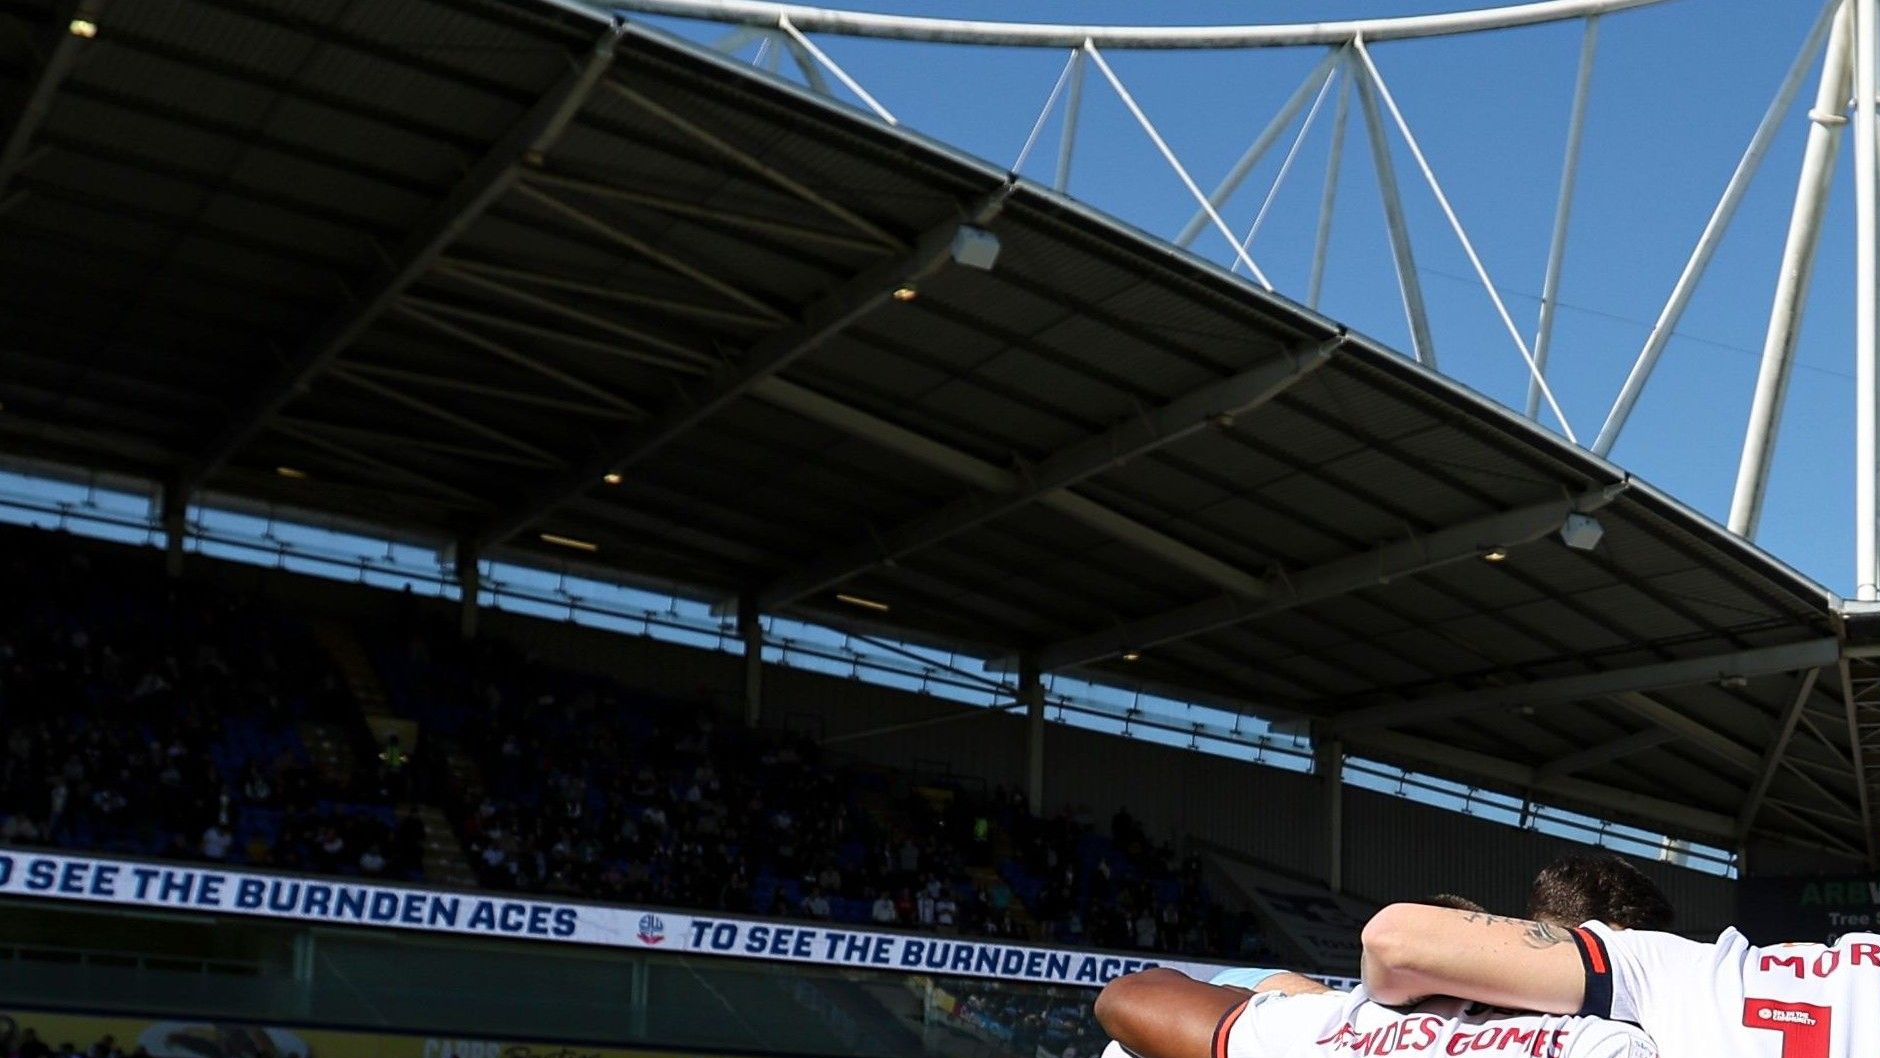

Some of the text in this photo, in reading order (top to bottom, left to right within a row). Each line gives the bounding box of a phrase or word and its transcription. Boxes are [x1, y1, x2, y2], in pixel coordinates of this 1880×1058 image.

[25, 859, 119, 897] SEE
[133, 867, 225, 907] THE
[236, 876, 460, 929] BURNDEN
[467, 901, 578, 937] ACES
[1829, 912, 1870, 926] Tree
[691, 920, 1160, 983] TO SEE THE BURNDEN ACE
